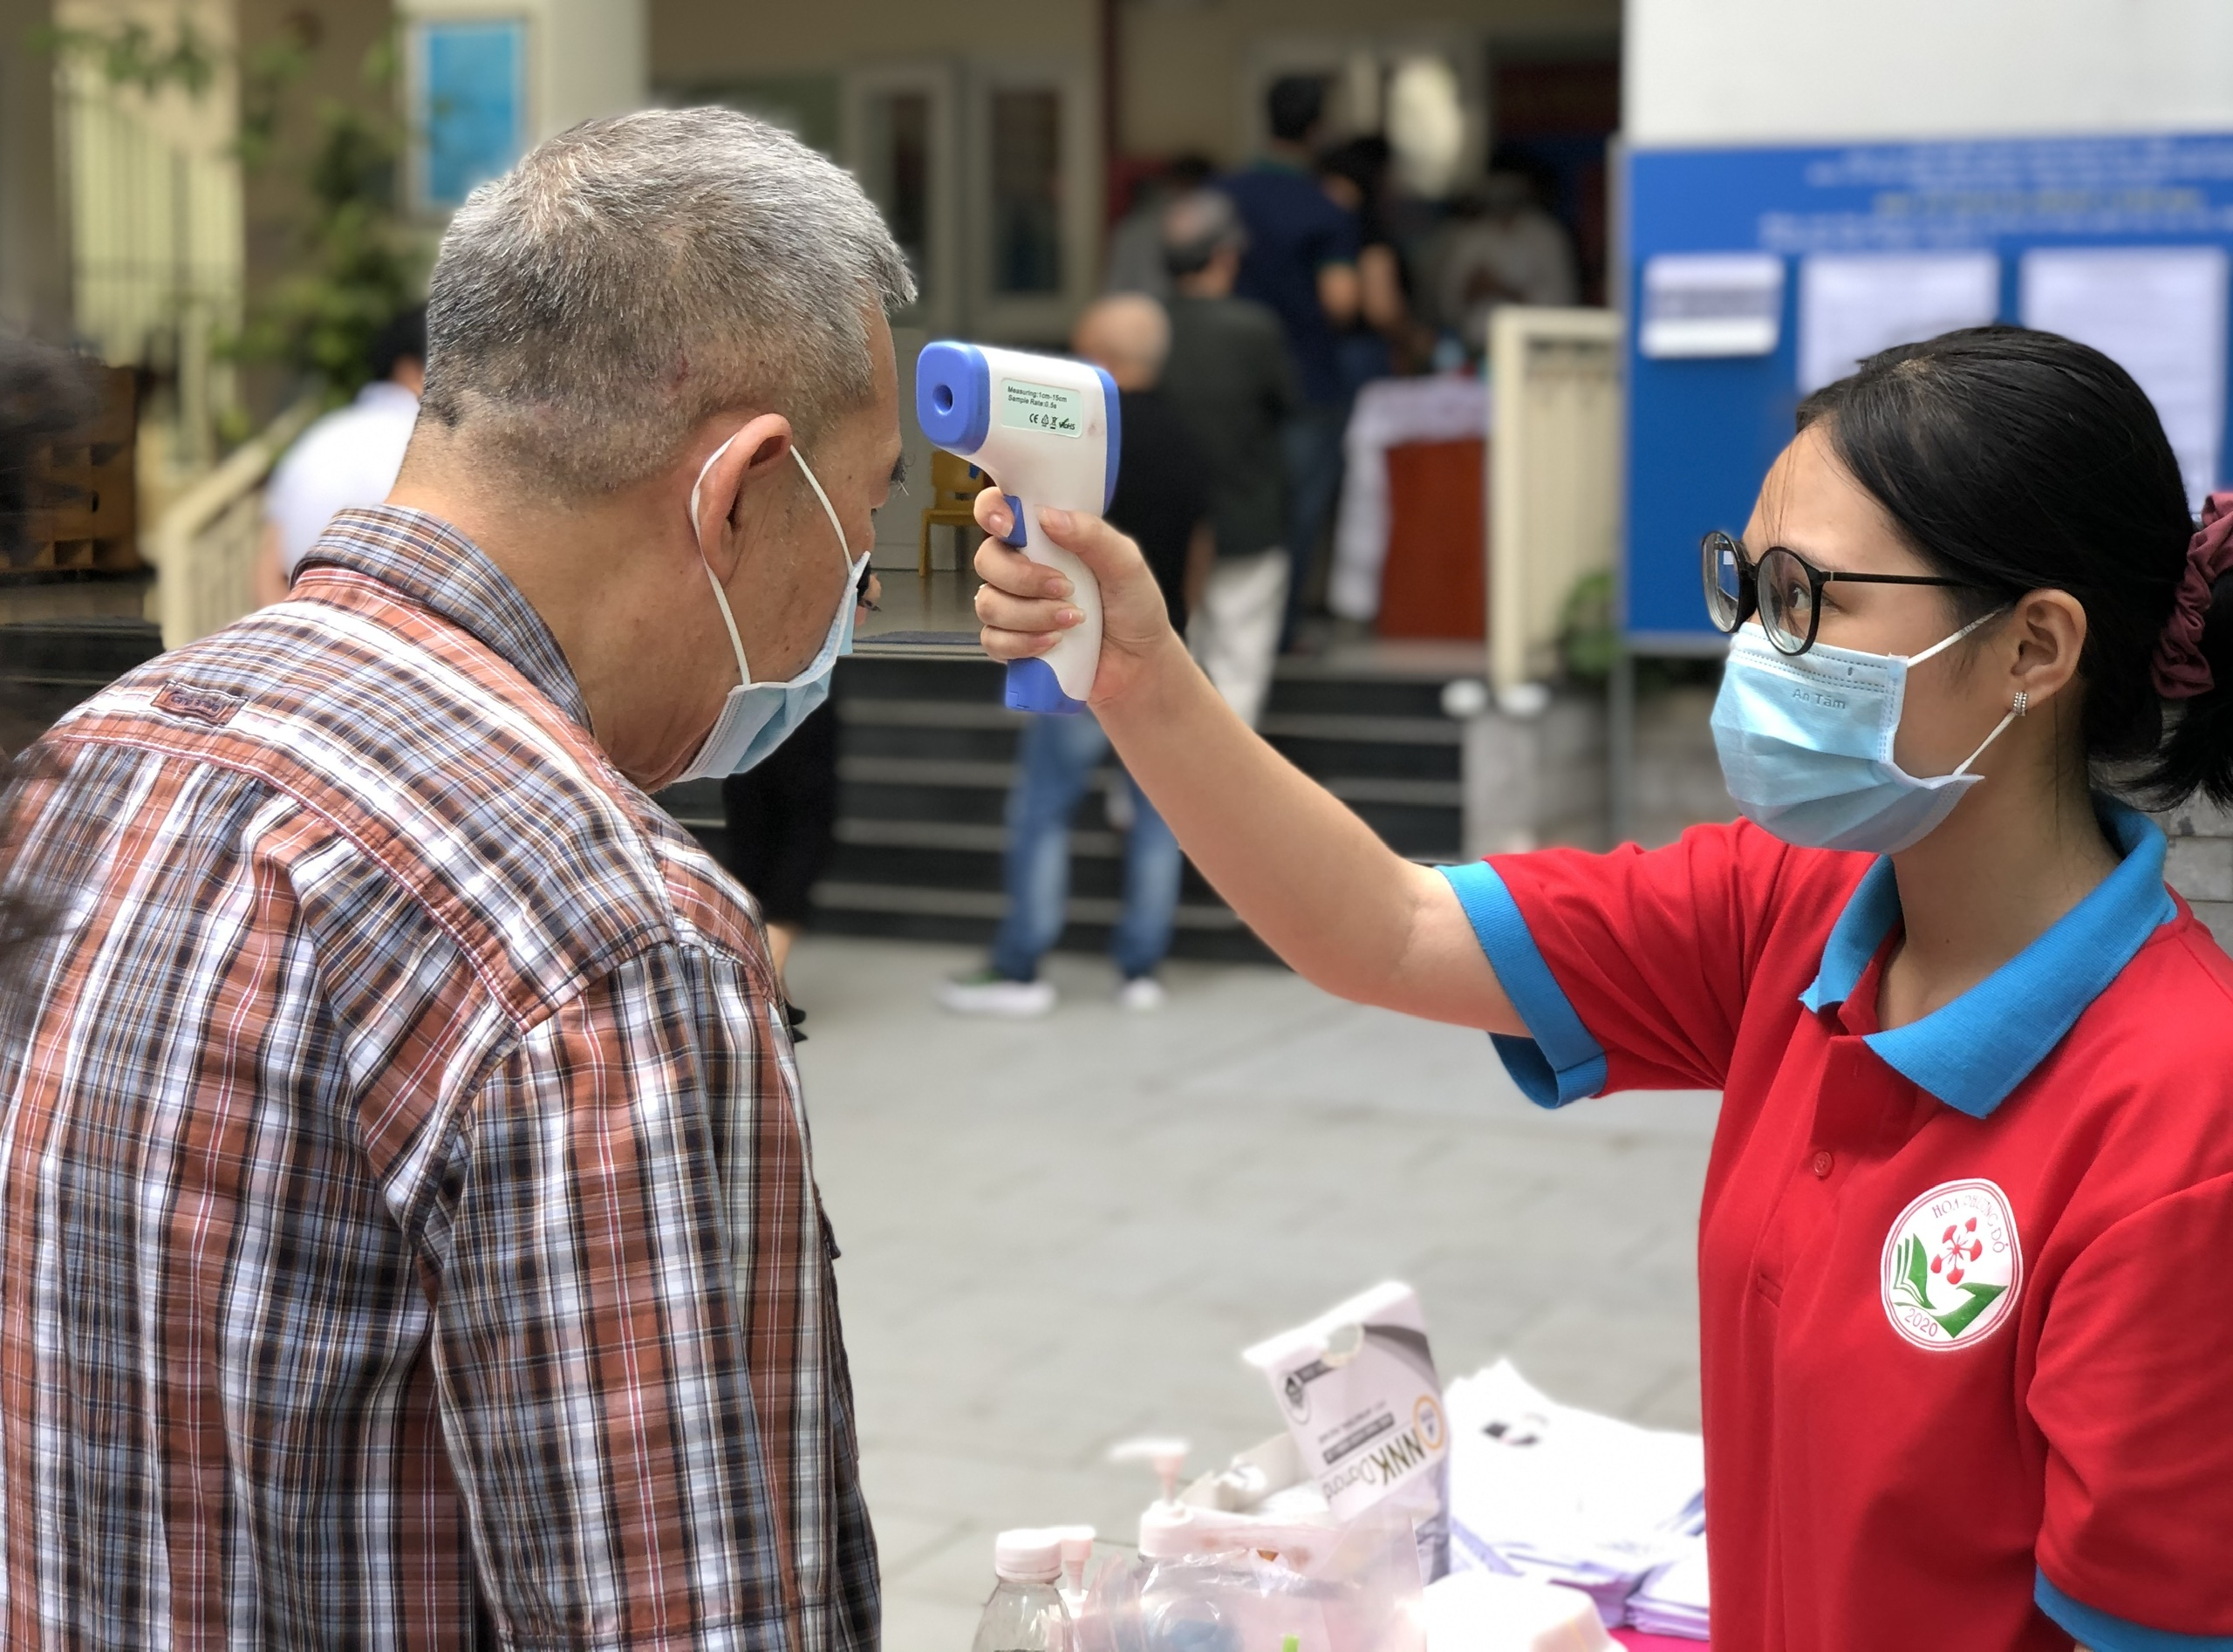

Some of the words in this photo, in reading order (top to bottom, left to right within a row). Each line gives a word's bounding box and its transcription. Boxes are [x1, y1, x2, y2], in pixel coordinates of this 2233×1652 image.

[1007, 394, 1029, 404] Sample
[1029, 413, 1039, 424] CE
[1793, 688, 1810, 701] An
[1931, 1198, 1959, 1219] HOA
[1904, 1307, 1938, 1337] 2020
[1369, 1427, 1426, 1486] NNK
